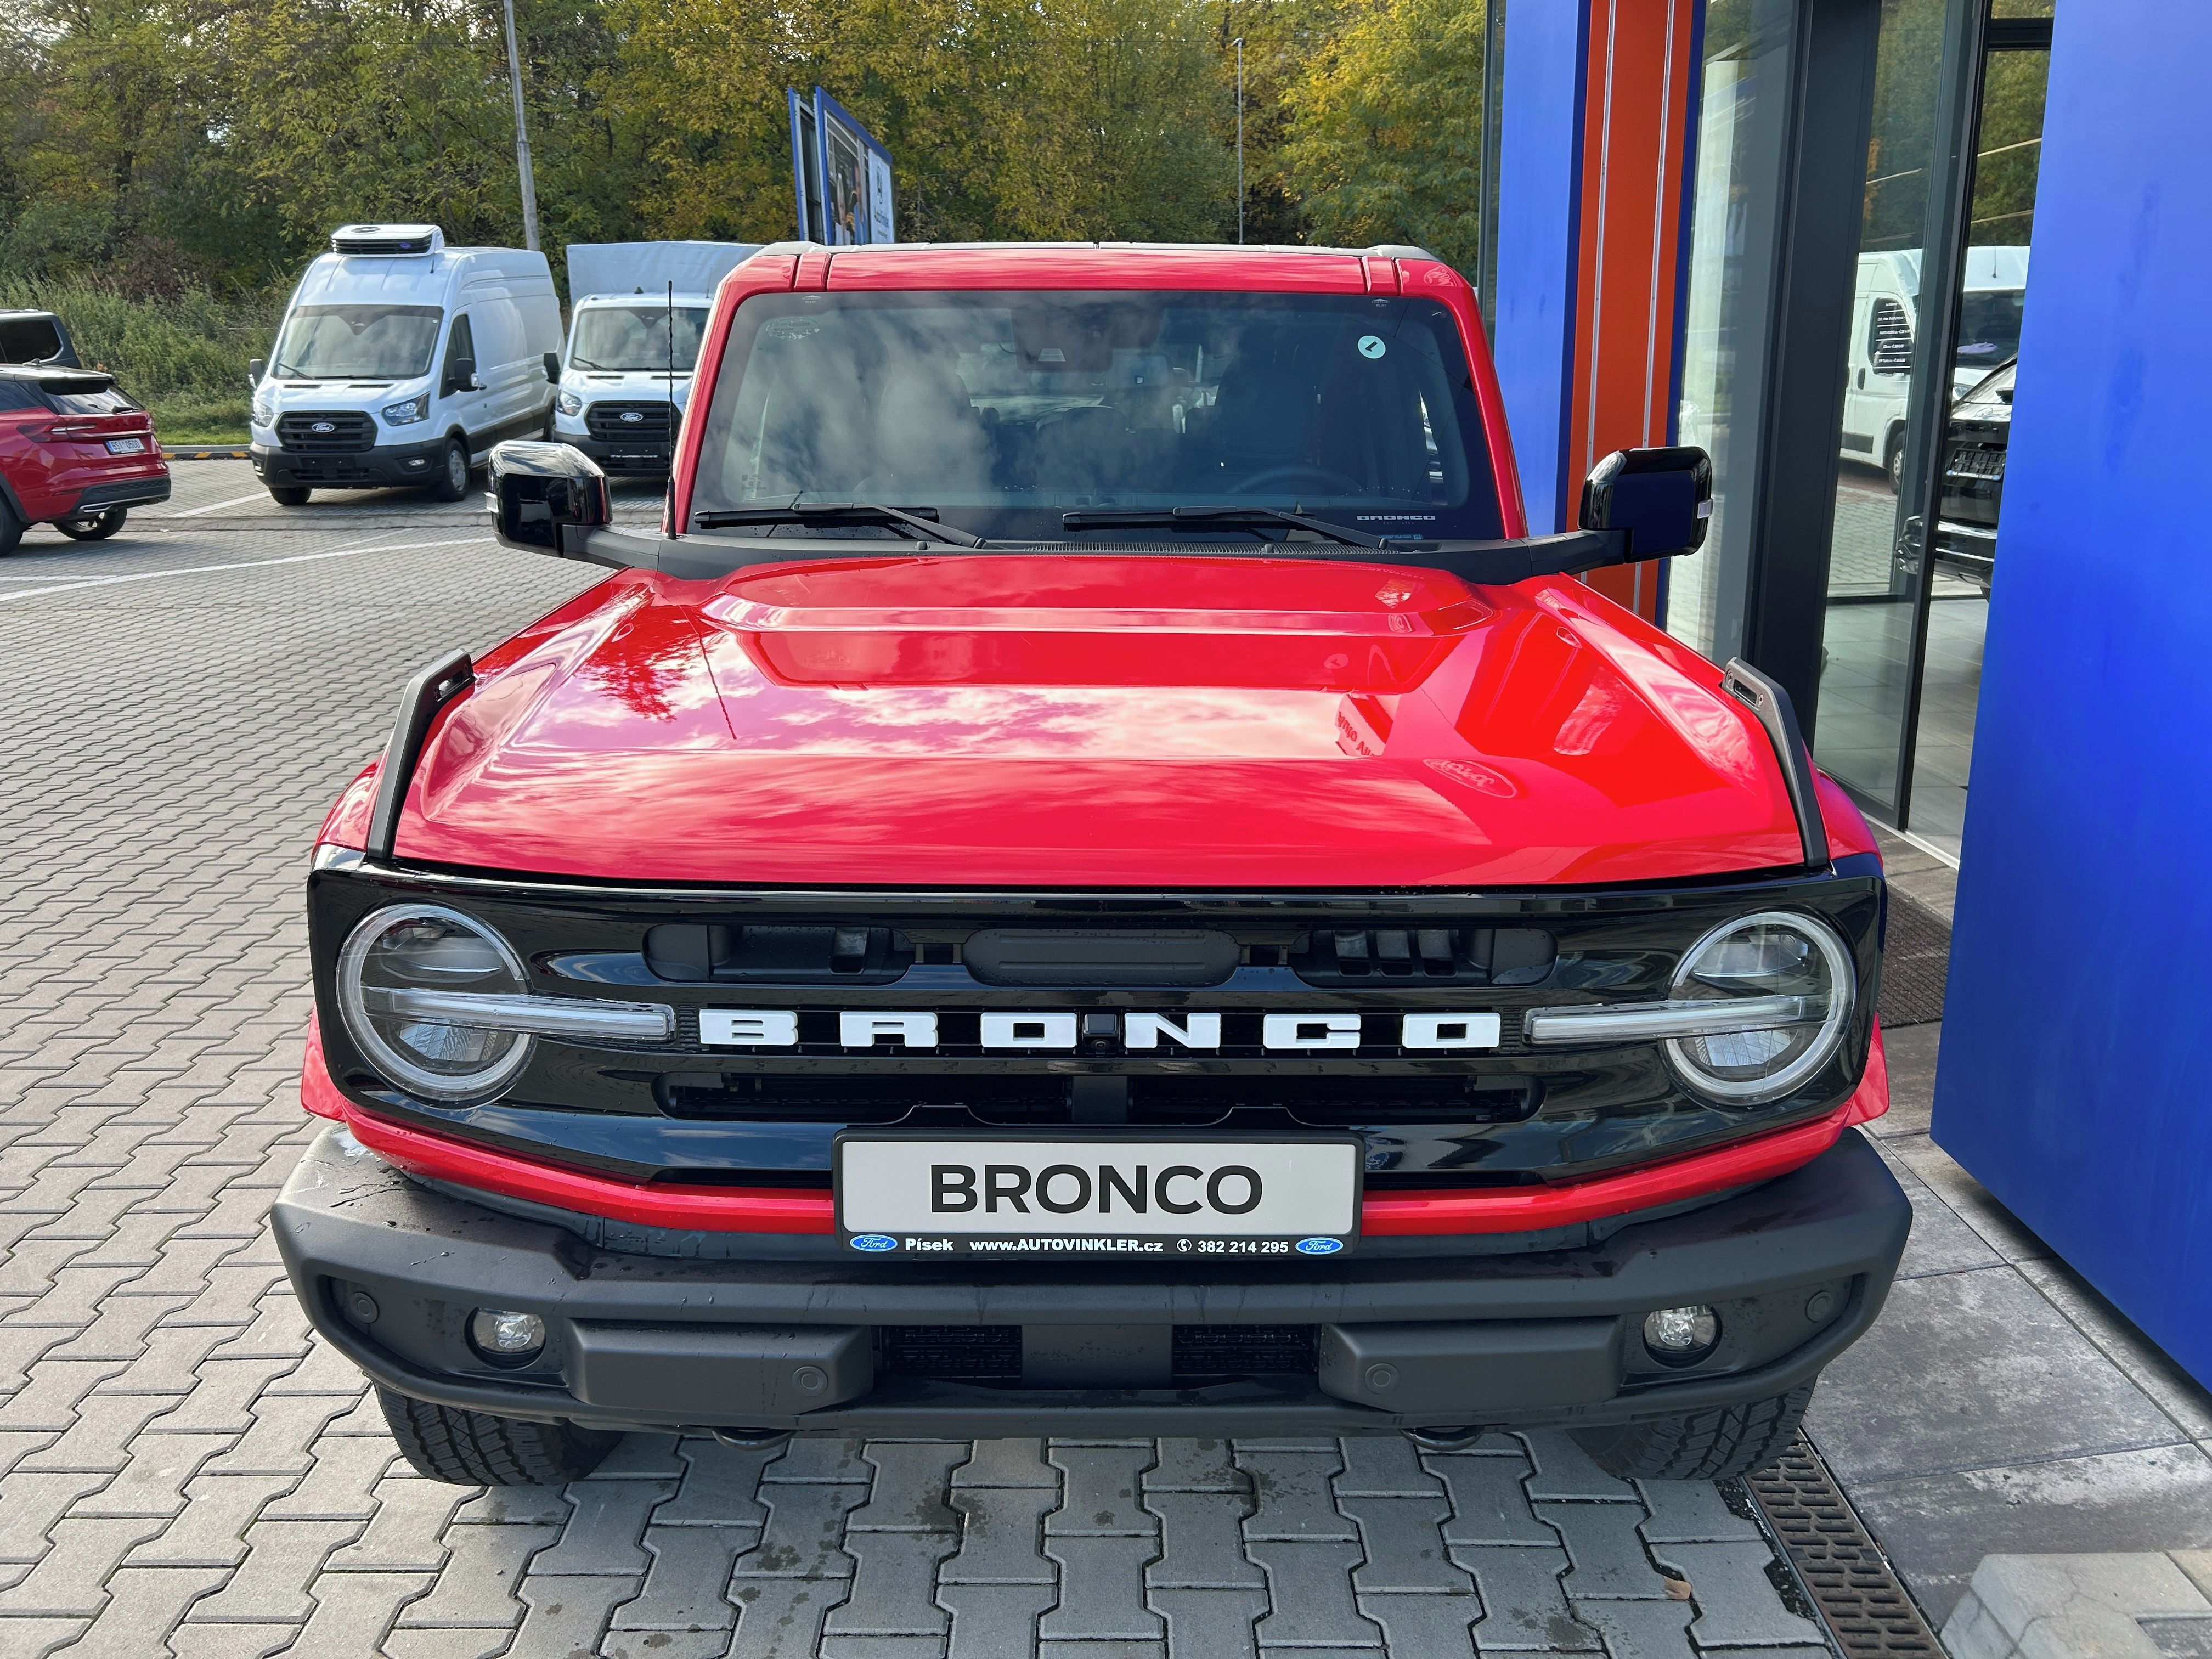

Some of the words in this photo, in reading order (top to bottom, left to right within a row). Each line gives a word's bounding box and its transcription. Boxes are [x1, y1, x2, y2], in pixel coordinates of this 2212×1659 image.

[699, 1009, 1501, 1049] BRONCO
[930, 1164, 1263, 1215] BRONCO
[860, 1237, 888, 1248] Ford
[905, 1238, 954, 1251] Písek
[969, 1238, 1163, 1252] www.AUTOVINKLER.cz
[1198, 1240, 1225, 1253] 382
[1229, 1241, 1257, 1253] 214
[1261, 1241, 1289, 1253] 295
[1305, 1240, 1333, 1251] Ford
